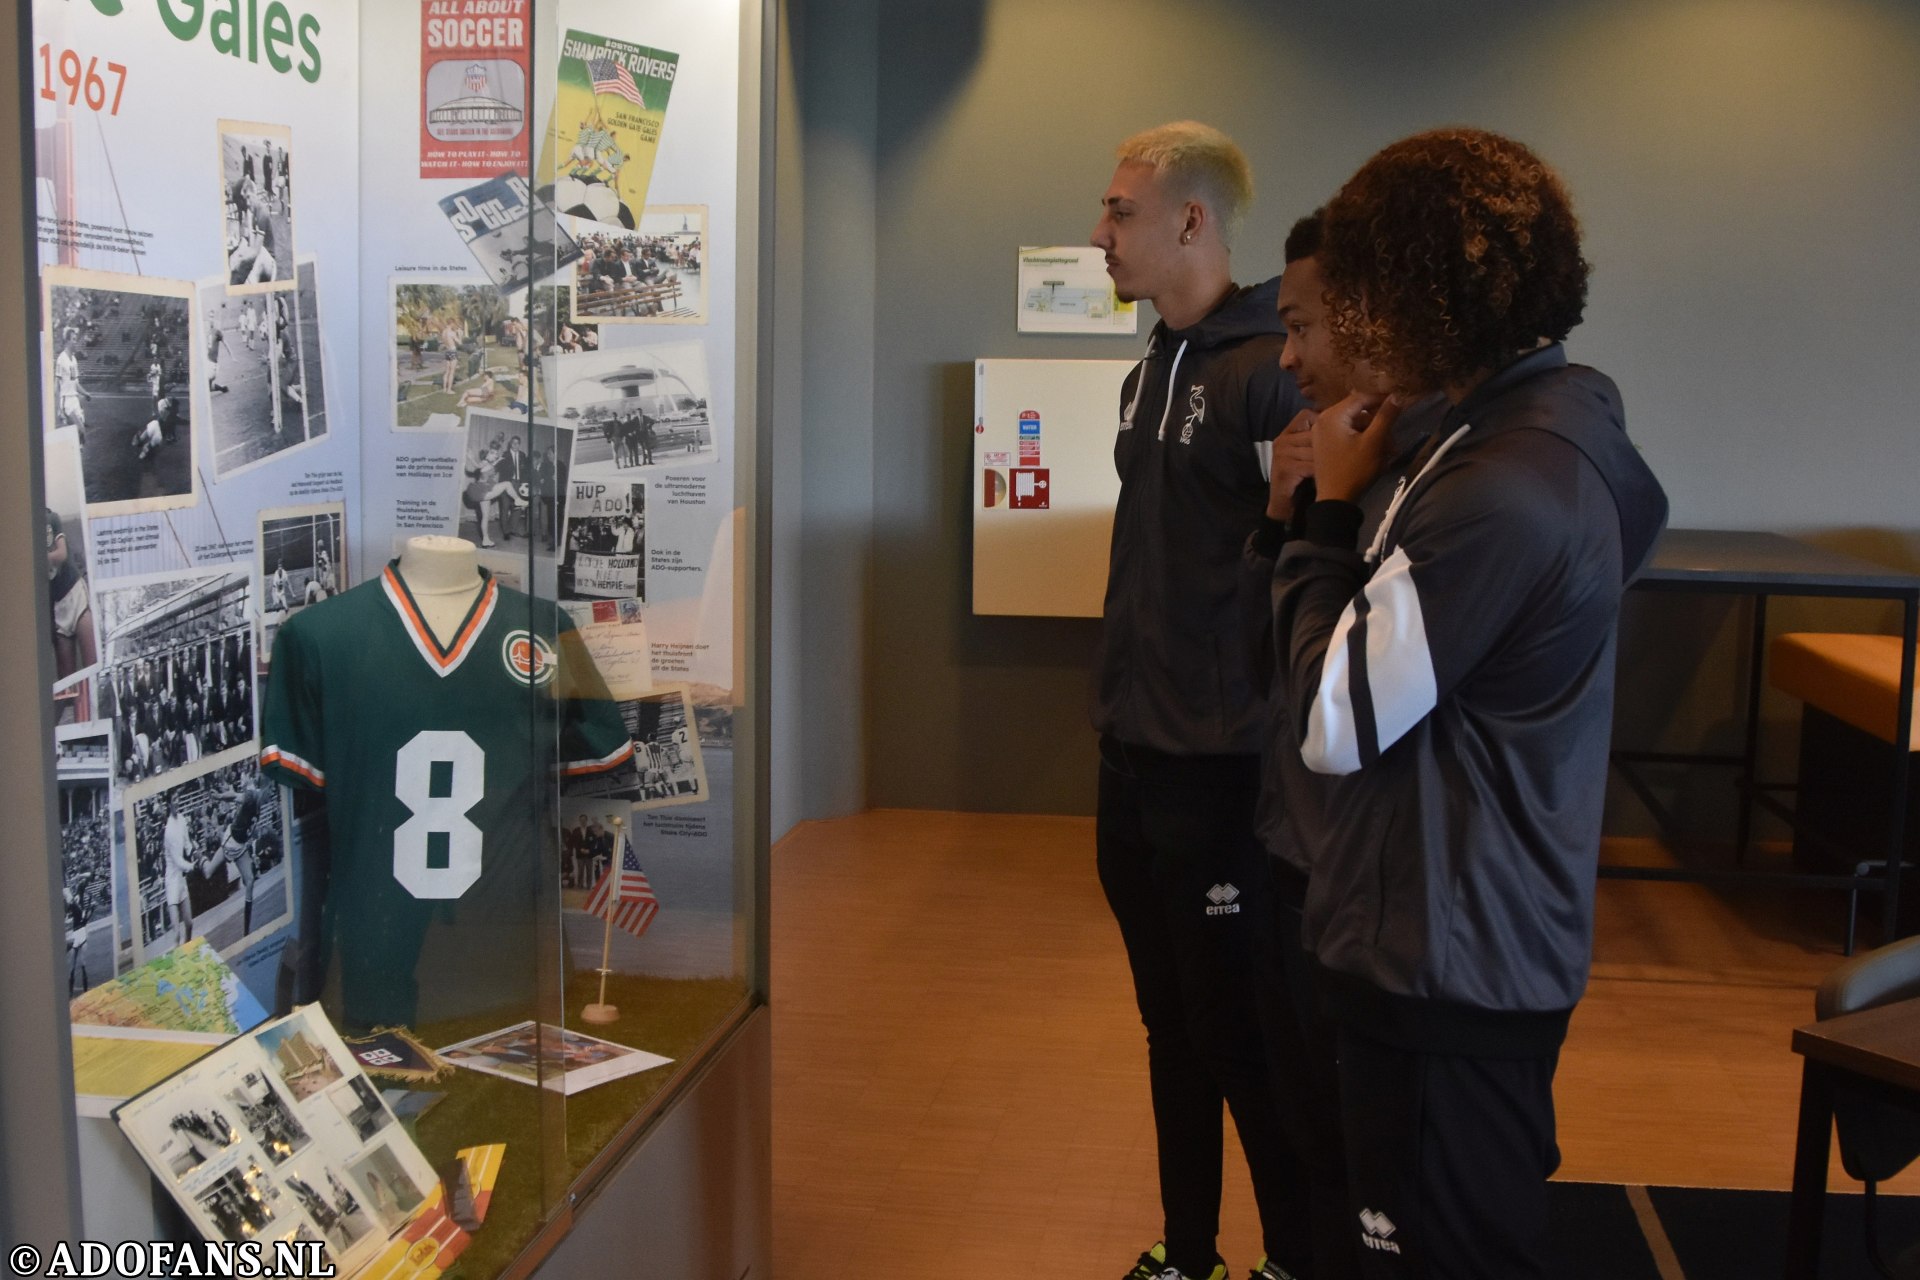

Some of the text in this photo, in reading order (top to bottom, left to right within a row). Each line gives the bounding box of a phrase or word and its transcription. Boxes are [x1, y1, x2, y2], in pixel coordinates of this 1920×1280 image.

[428, 0, 524, 14] ALL ABOUT
[427, 17, 524, 48] SOCCER
[157, 0, 321, 83] Gales
[605, 39, 640, 54] BOSTON
[563, 38, 677, 80] SHAMROCK ROVERS
[39, 42, 128, 117] 1967
[607, 118, 628, 128] GOLDEN
[628, 122, 641, 132] GATE
[616, 111, 660, 128] SAN FRANCISCO
[427, 150, 521, 158] HOW TO PLAY IT HOW TO
[420, 160, 448, 168] WATCH
[449, 160, 457, 168] IT
[461, 160, 480, 168] HOW
[482, 160, 492, 168] TO
[492, 160, 515, 168] ENJOY
[576, 484, 606, 500] HUP
[679, 731, 688, 743] 2
[393, 731, 486, 899] 8
[1206, 903, 1240, 915] errea
[1362, 1233, 1400, 1254] errea
